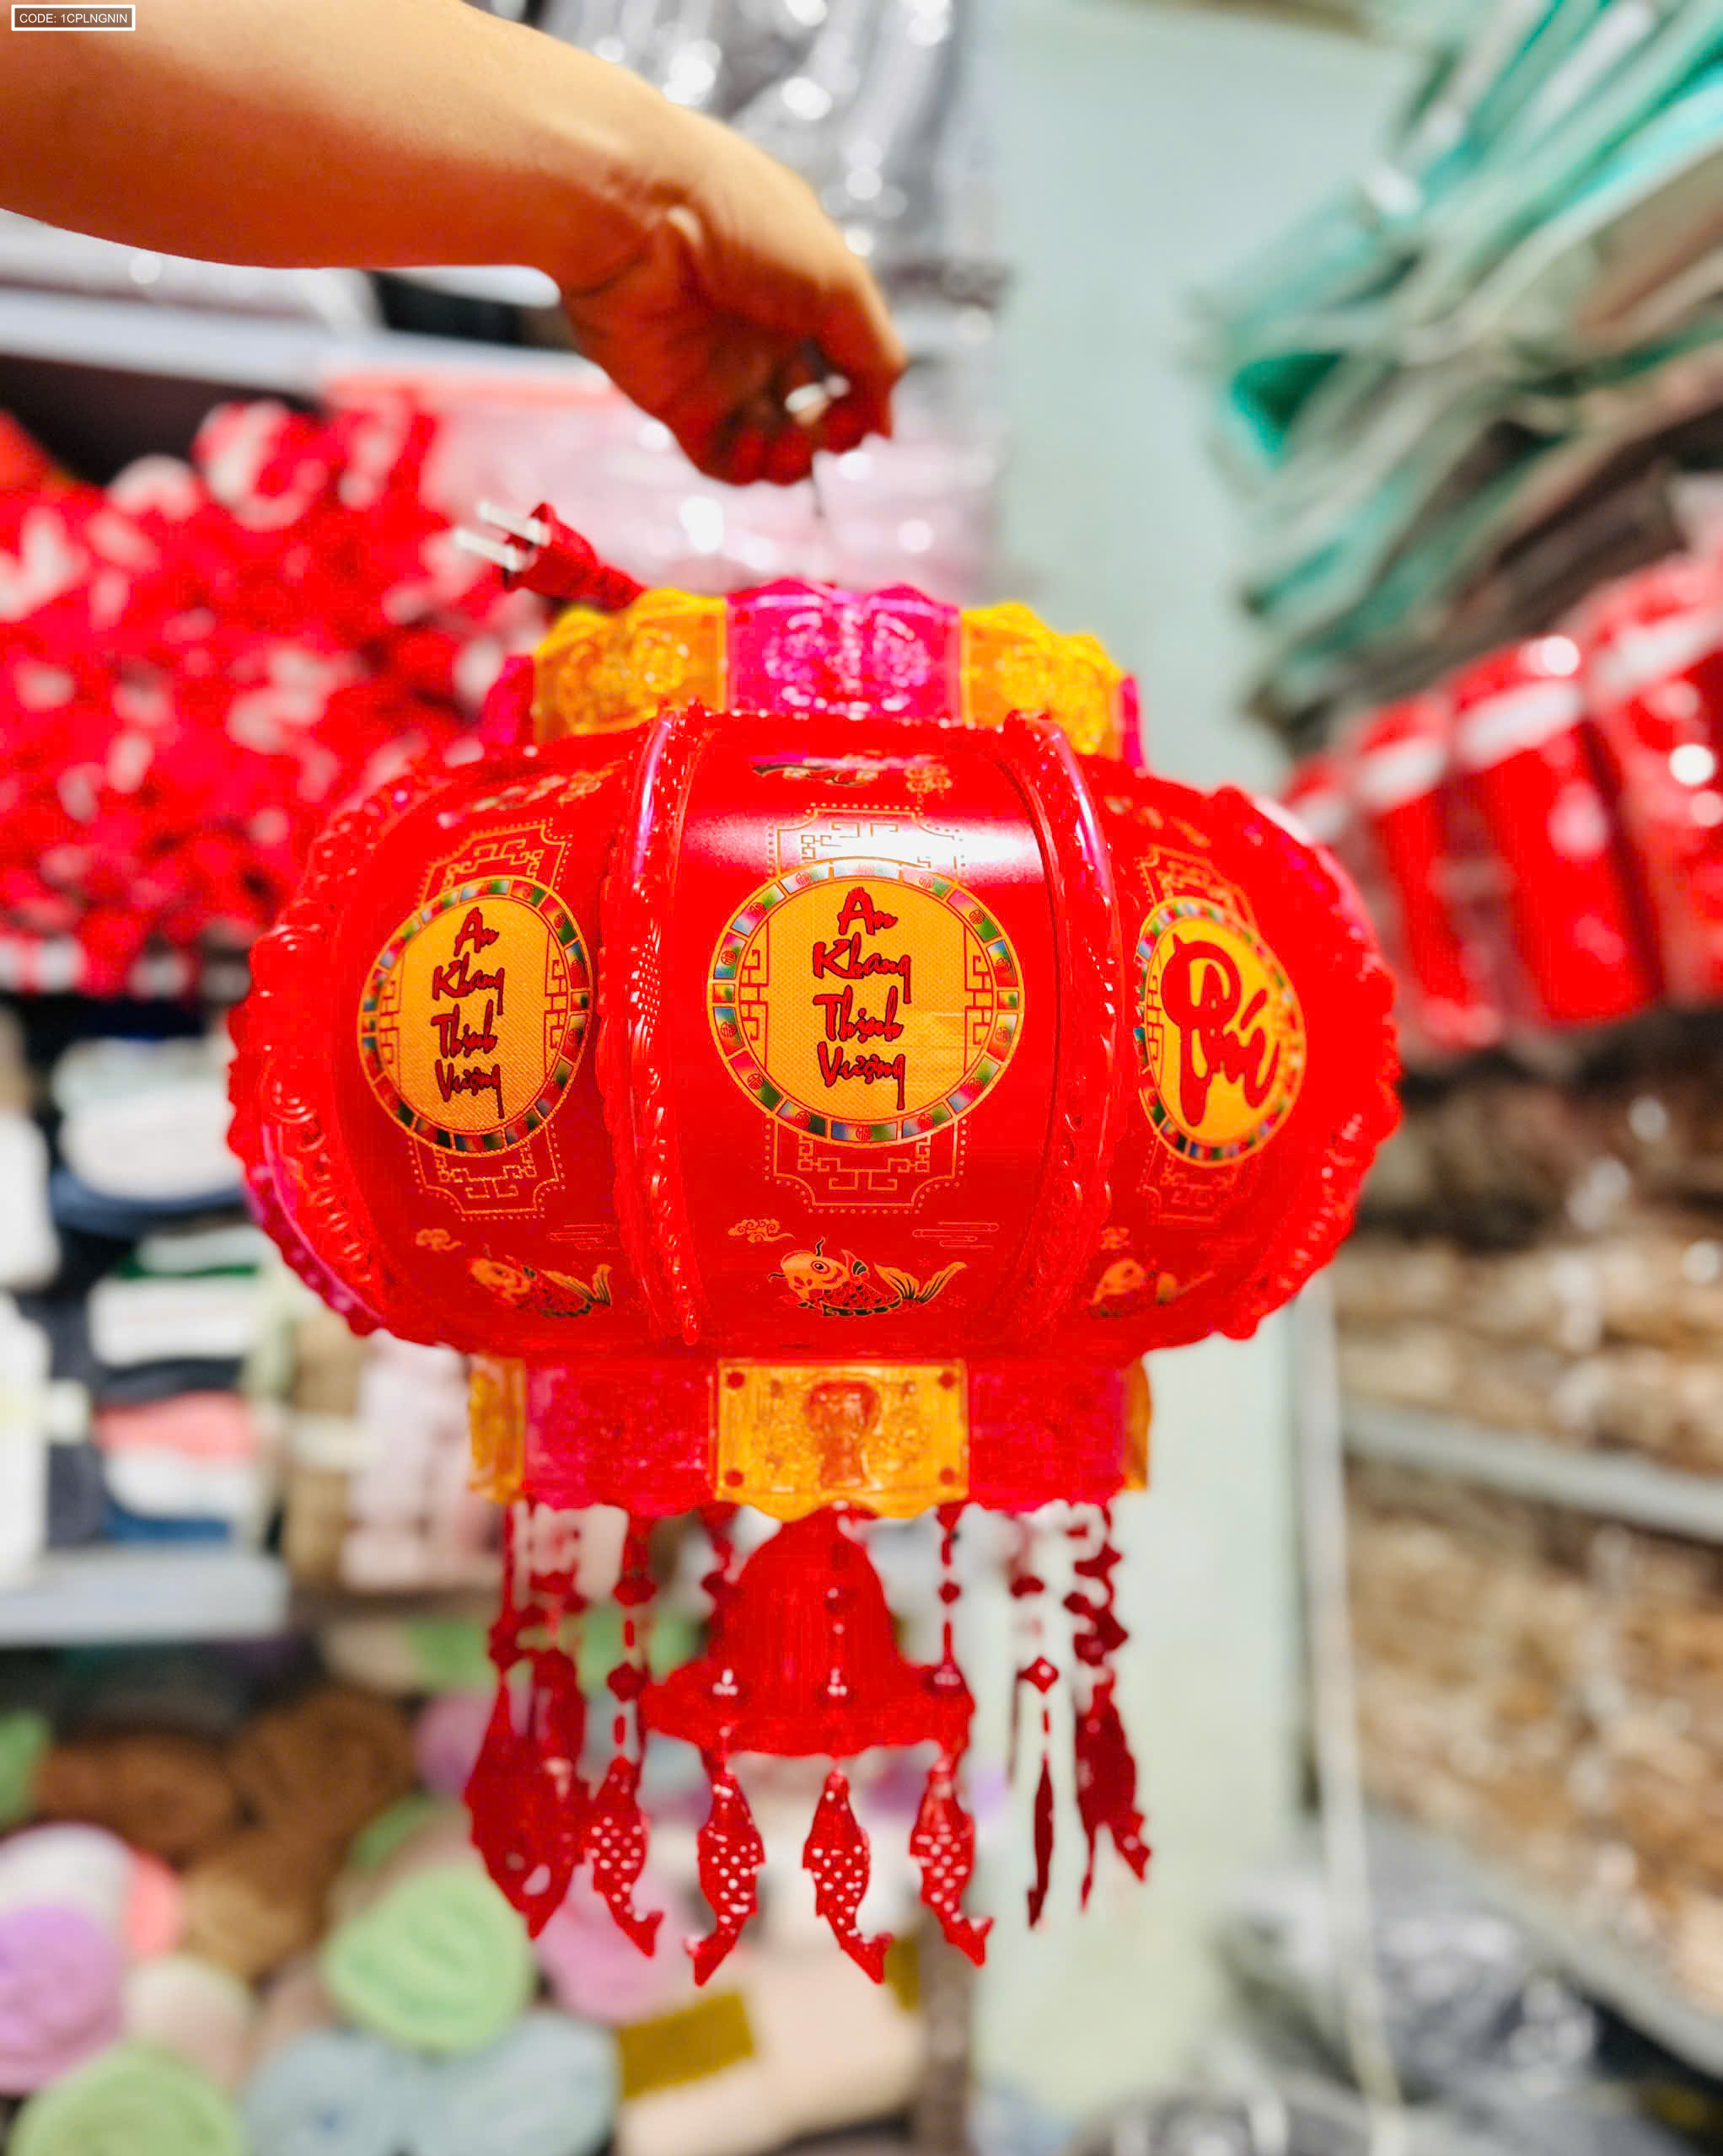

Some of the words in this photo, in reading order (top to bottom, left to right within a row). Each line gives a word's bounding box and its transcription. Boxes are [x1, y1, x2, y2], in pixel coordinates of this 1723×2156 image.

[454, 907, 499, 957] An
[837, 887, 899, 936] An
[432, 952, 505, 1016] Khang
[813, 931, 912, 1005] Khang
[430, 999, 499, 1059] Thịnh
[813, 984, 904, 1043] Thịnh
[817, 1041, 905, 1111] Vượng
